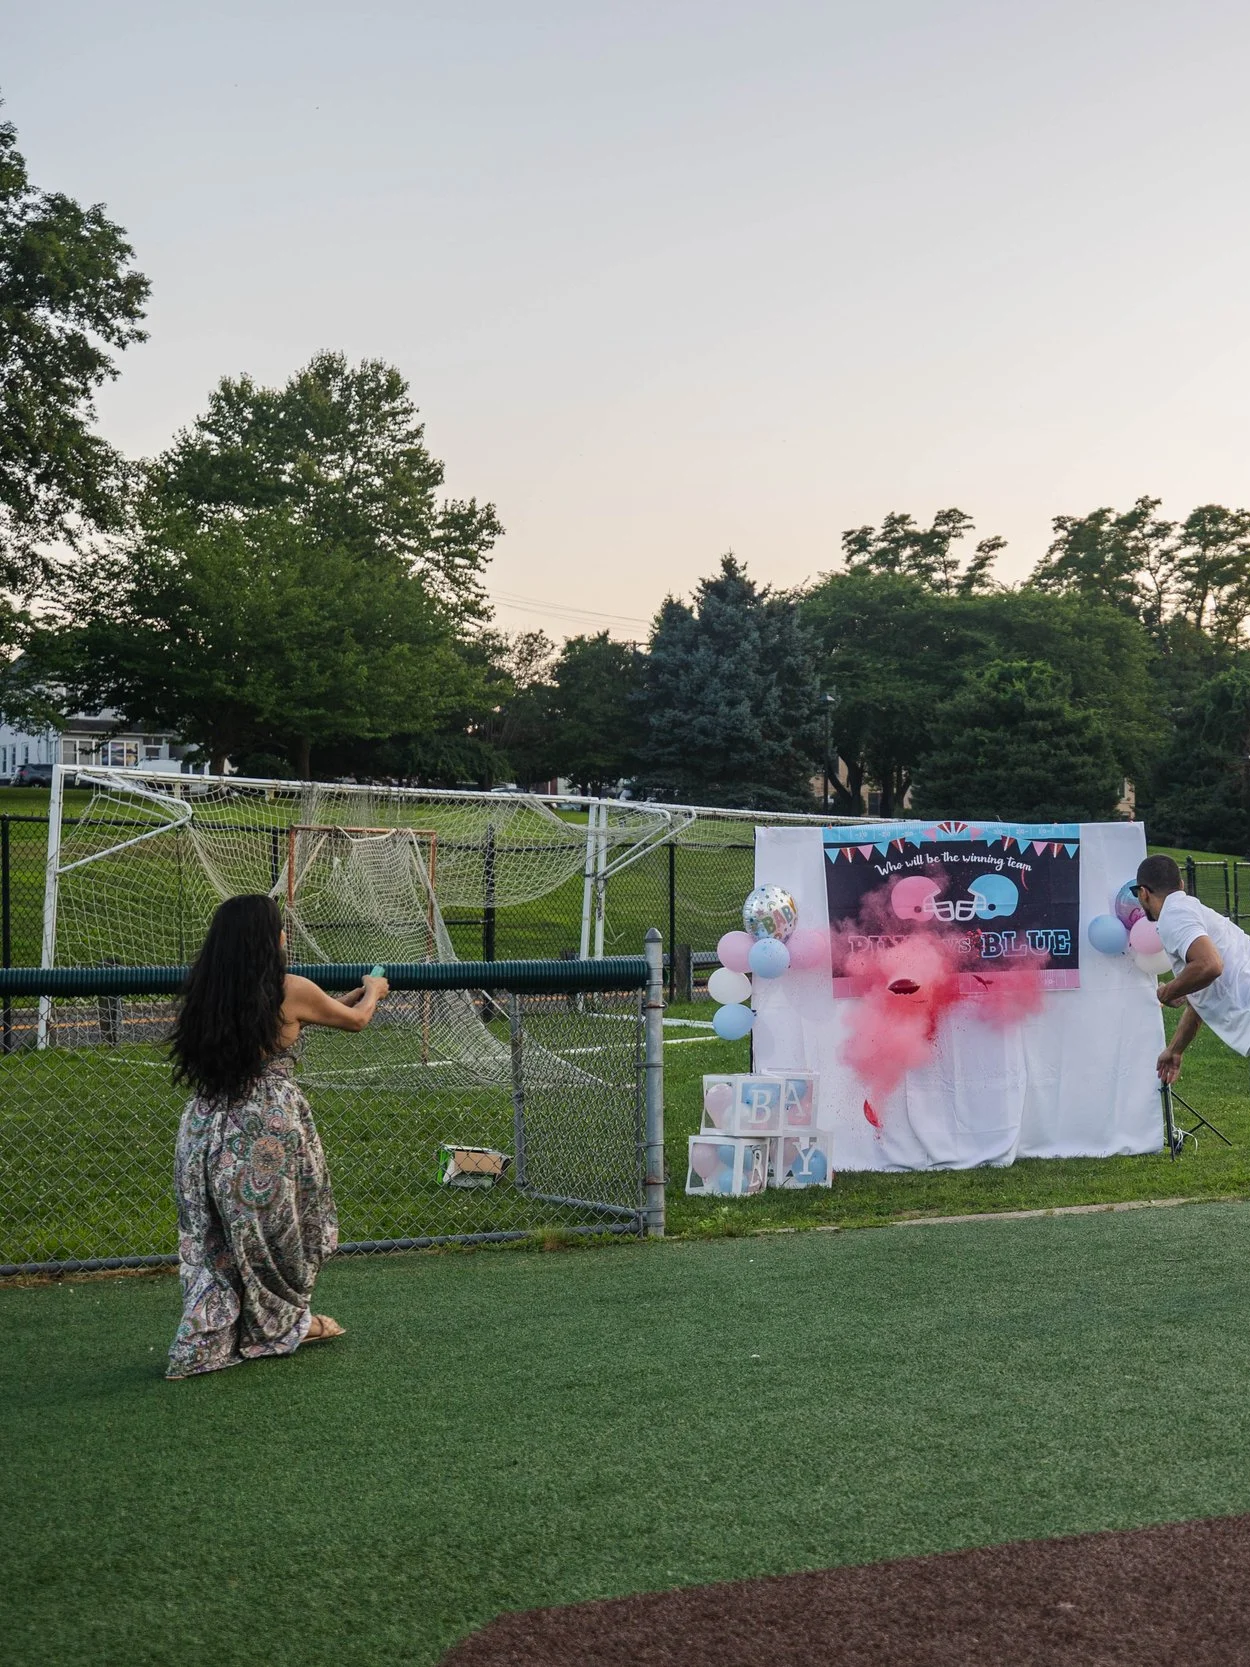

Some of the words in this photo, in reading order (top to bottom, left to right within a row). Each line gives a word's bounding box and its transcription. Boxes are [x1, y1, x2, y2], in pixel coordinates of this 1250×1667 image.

[875, 861, 902, 876] Who
[905, 855, 924, 868] will
[926, 853, 940, 864] be
[941, 851, 960, 863] the
[962, 854, 1005, 872] winning
[1007, 856, 1032, 872] team
[981, 930, 1071, 958] BLUE
[749, 1089, 772, 1123] B
[793, 1141, 817, 1175] Y
